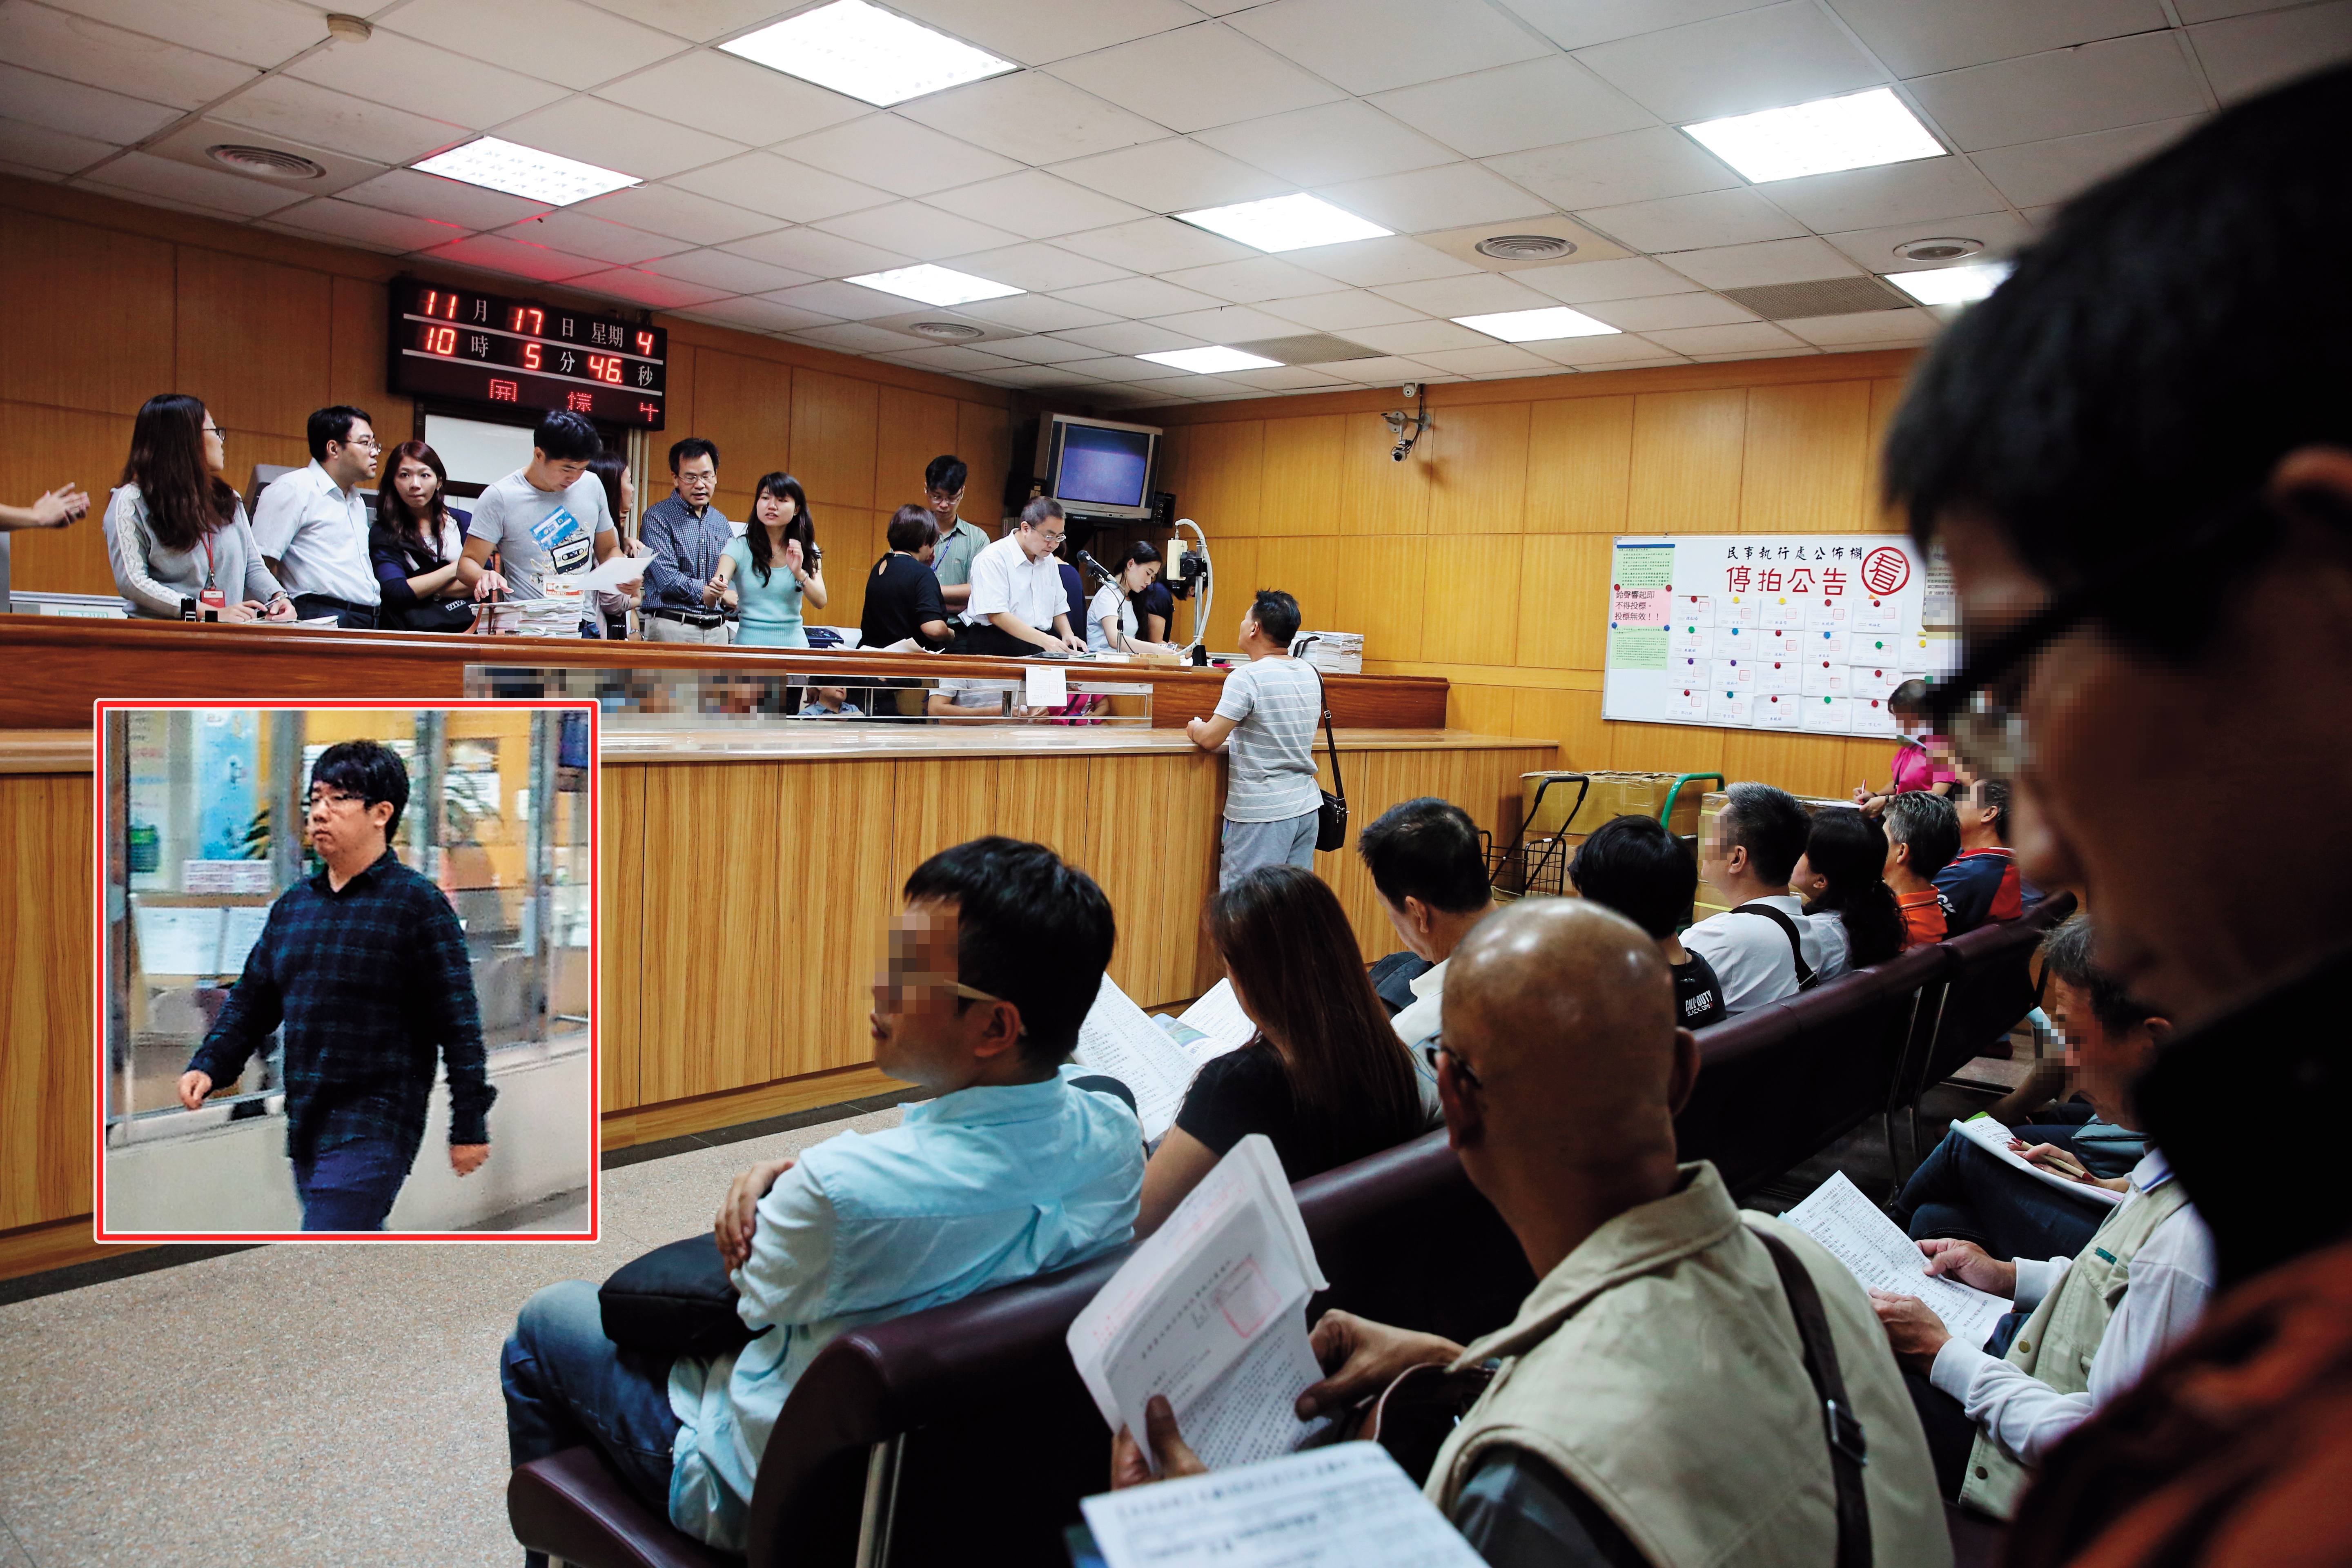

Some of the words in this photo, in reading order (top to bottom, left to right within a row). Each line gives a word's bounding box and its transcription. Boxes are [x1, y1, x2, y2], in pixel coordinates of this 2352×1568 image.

[428, 292, 456, 318] 11
[473, 299, 487, 322] 月
[516, 309, 542, 334] 17
[562, 318, 574, 338] 日
[591, 322, 624, 348] 星期
[638, 332, 653, 355] 4
[427, 327, 455, 354] 10
[471, 335, 489, 358] 時
[525, 343, 541, 368] 5
[560, 351, 575, 373] 分
[637, 365, 653, 386] 秒
[1727, 546, 1862, 561] 民事執行處公佈欄
[1726, 565, 1847, 595] 停拍公告
[1616, 591, 1655, 599] 鈴聲響起即
[1696, 990, 1712, 1006] DUTY
[1687, 1007, 1702, 1016] BLACK
